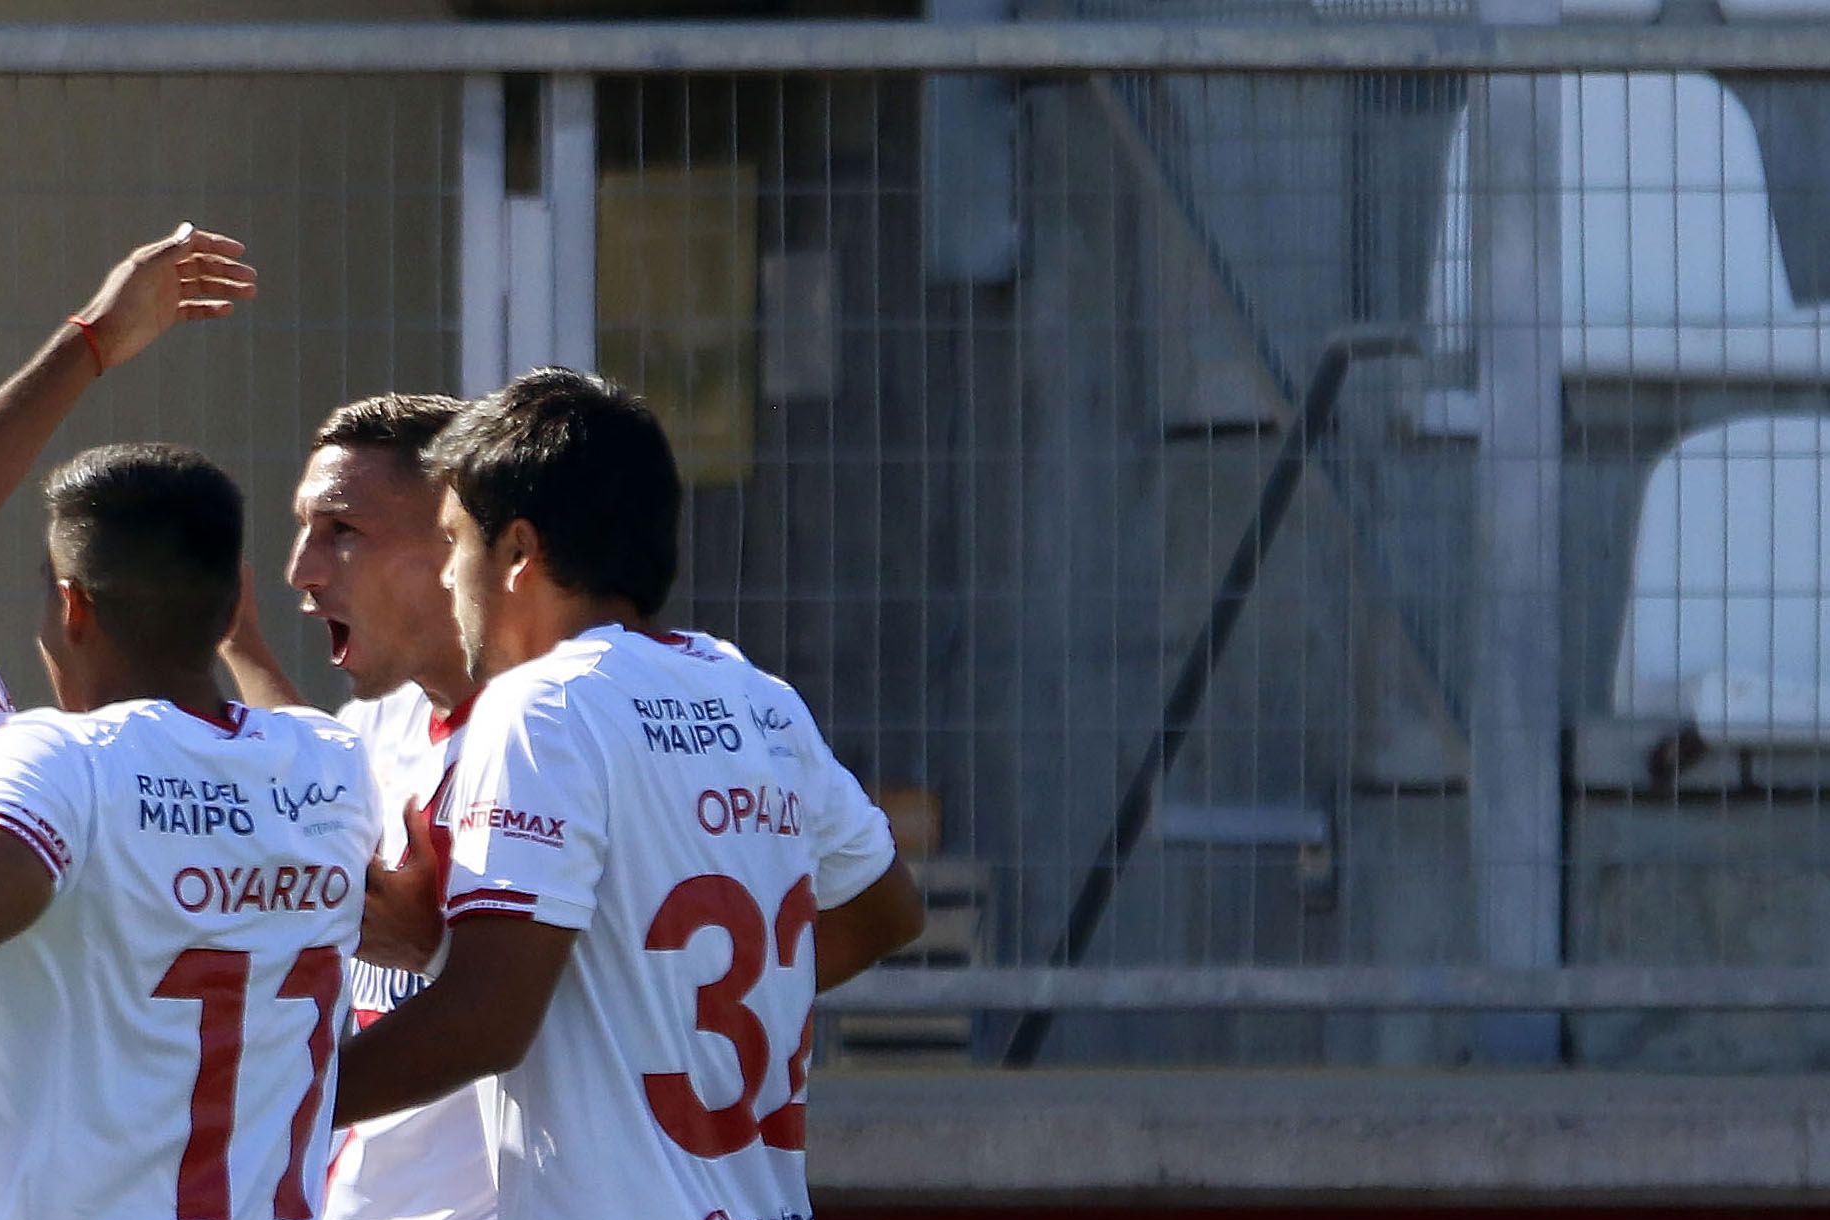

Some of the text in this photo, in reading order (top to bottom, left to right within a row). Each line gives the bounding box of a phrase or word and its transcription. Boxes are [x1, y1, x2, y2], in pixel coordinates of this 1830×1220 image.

[632, 697, 735, 721] RUTA DEL
[642, 722, 743, 755] MAIPO
[136, 774, 250, 805] RUTA DEL
[139, 799, 256, 837] MAIPO
[173, 864, 352, 914] OYARZO
